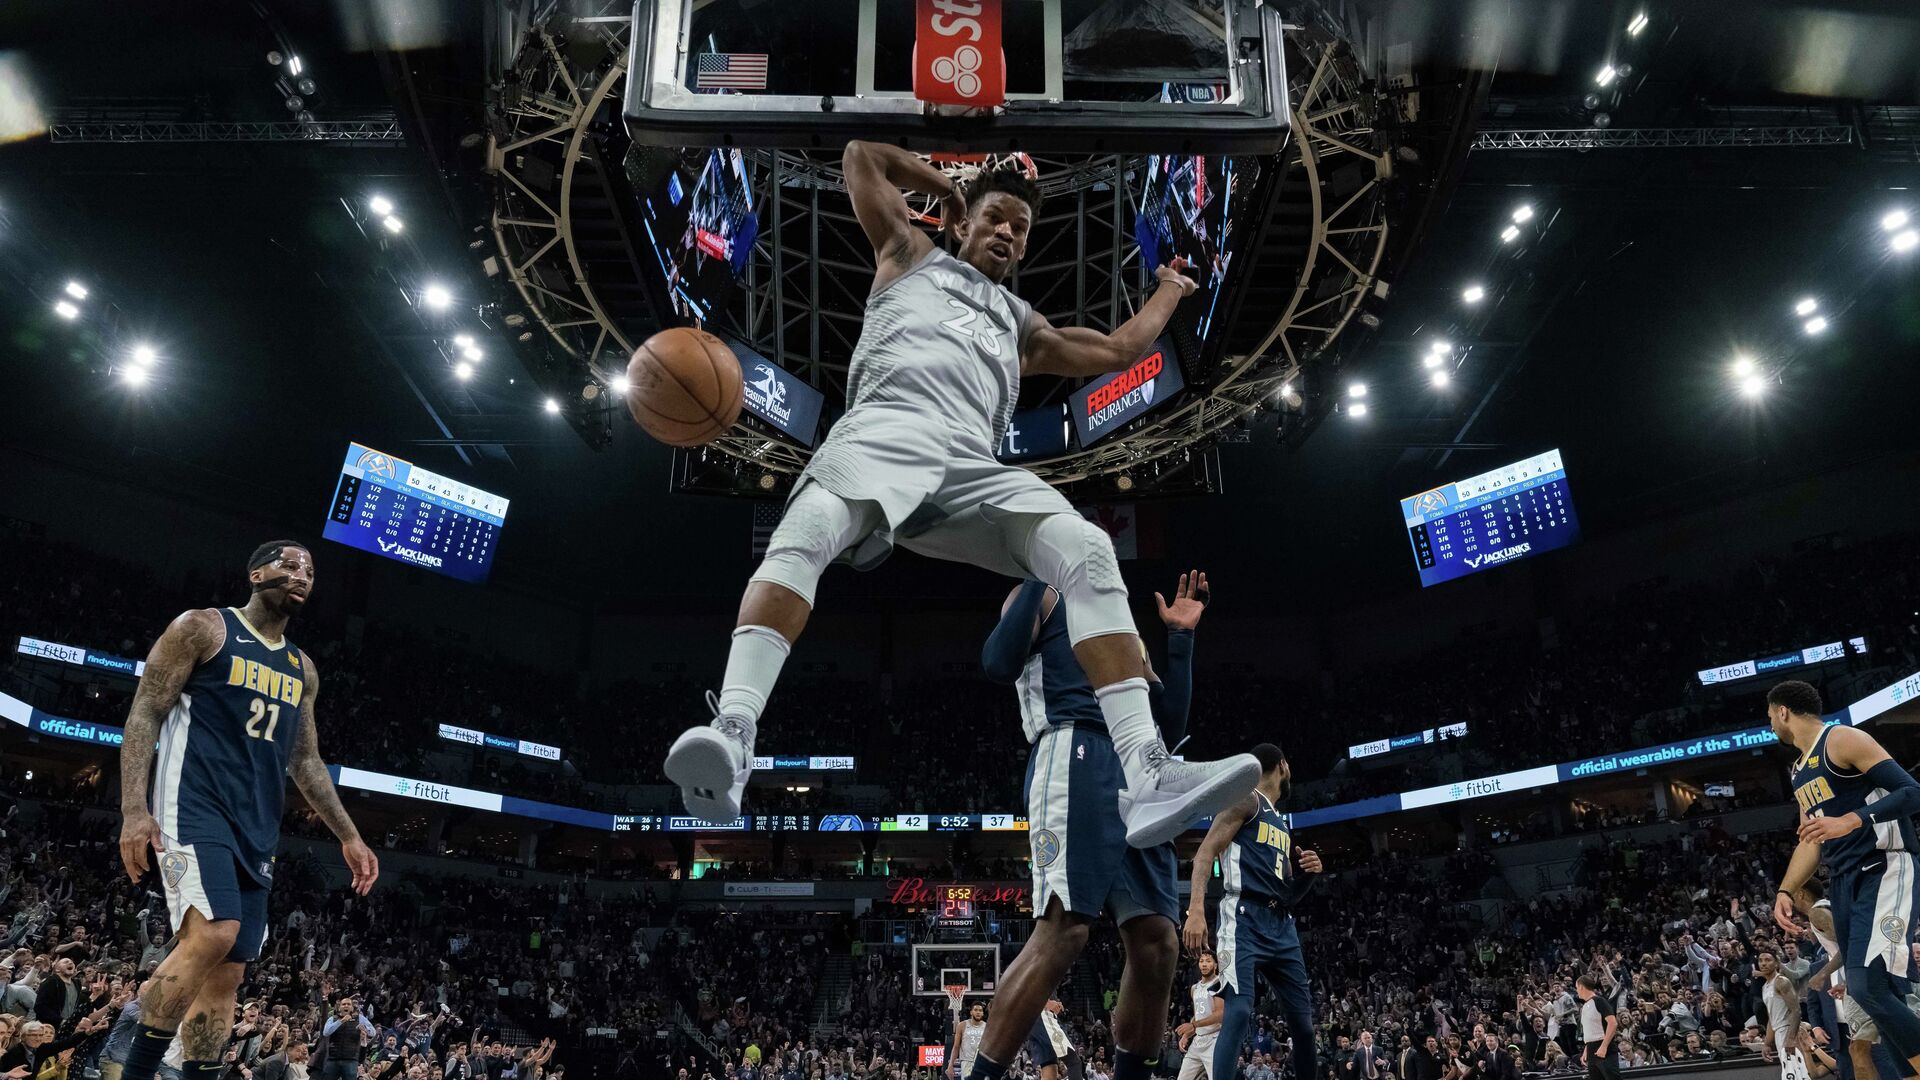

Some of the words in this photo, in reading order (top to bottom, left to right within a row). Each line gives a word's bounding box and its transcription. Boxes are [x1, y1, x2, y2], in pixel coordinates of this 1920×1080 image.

[1192, 87, 1210, 100] NBA
[939, 298, 1009, 357] 23
[1087, 351, 1163, 416] FEDERATED
[770, 400, 791, 420] Island
[1088, 386, 1141, 432] INSURANCE
[370, 485, 382, 493] 1/2
[420, 502, 431, 510] 0/0
[364, 502, 376, 510] 3/6
[362, 511, 374, 519] 0/3
[413, 527, 424, 535] 0/0
[386, 528, 398, 536] 0/0
[394, 545, 417, 560] JACK
[1484, 550, 1505, 564] JACK
[44, 644, 79, 662] fitbit
[87, 654, 133, 671] findyourfit
[1758, 655, 1800, 670] findyourfit
[1719, 665, 1750, 680] fitbit
[246, 698, 280, 742] 21
[40, 720, 96, 739] official
[455, 729, 479, 742] fitbit
[533, 745, 555, 758] fitbit
[1364, 743, 1386, 754] fitbit
[1572, 757, 1617, 776] official
[1619, 740, 1684, 768] wearable
[1686, 741, 1704, 756] of
[1705, 736, 1731, 754] the
[825, 759, 848, 768] fitbit
[414, 782, 450, 801] fitbit
[1466, 779, 1501, 796] fitbit
[905, 816, 920, 827] 42
[941, 816, 969, 827] 6:52
[990, 816, 1005, 827] 37
[948, 888, 970, 899] 6:52
[945, 900, 968, 917] 24
